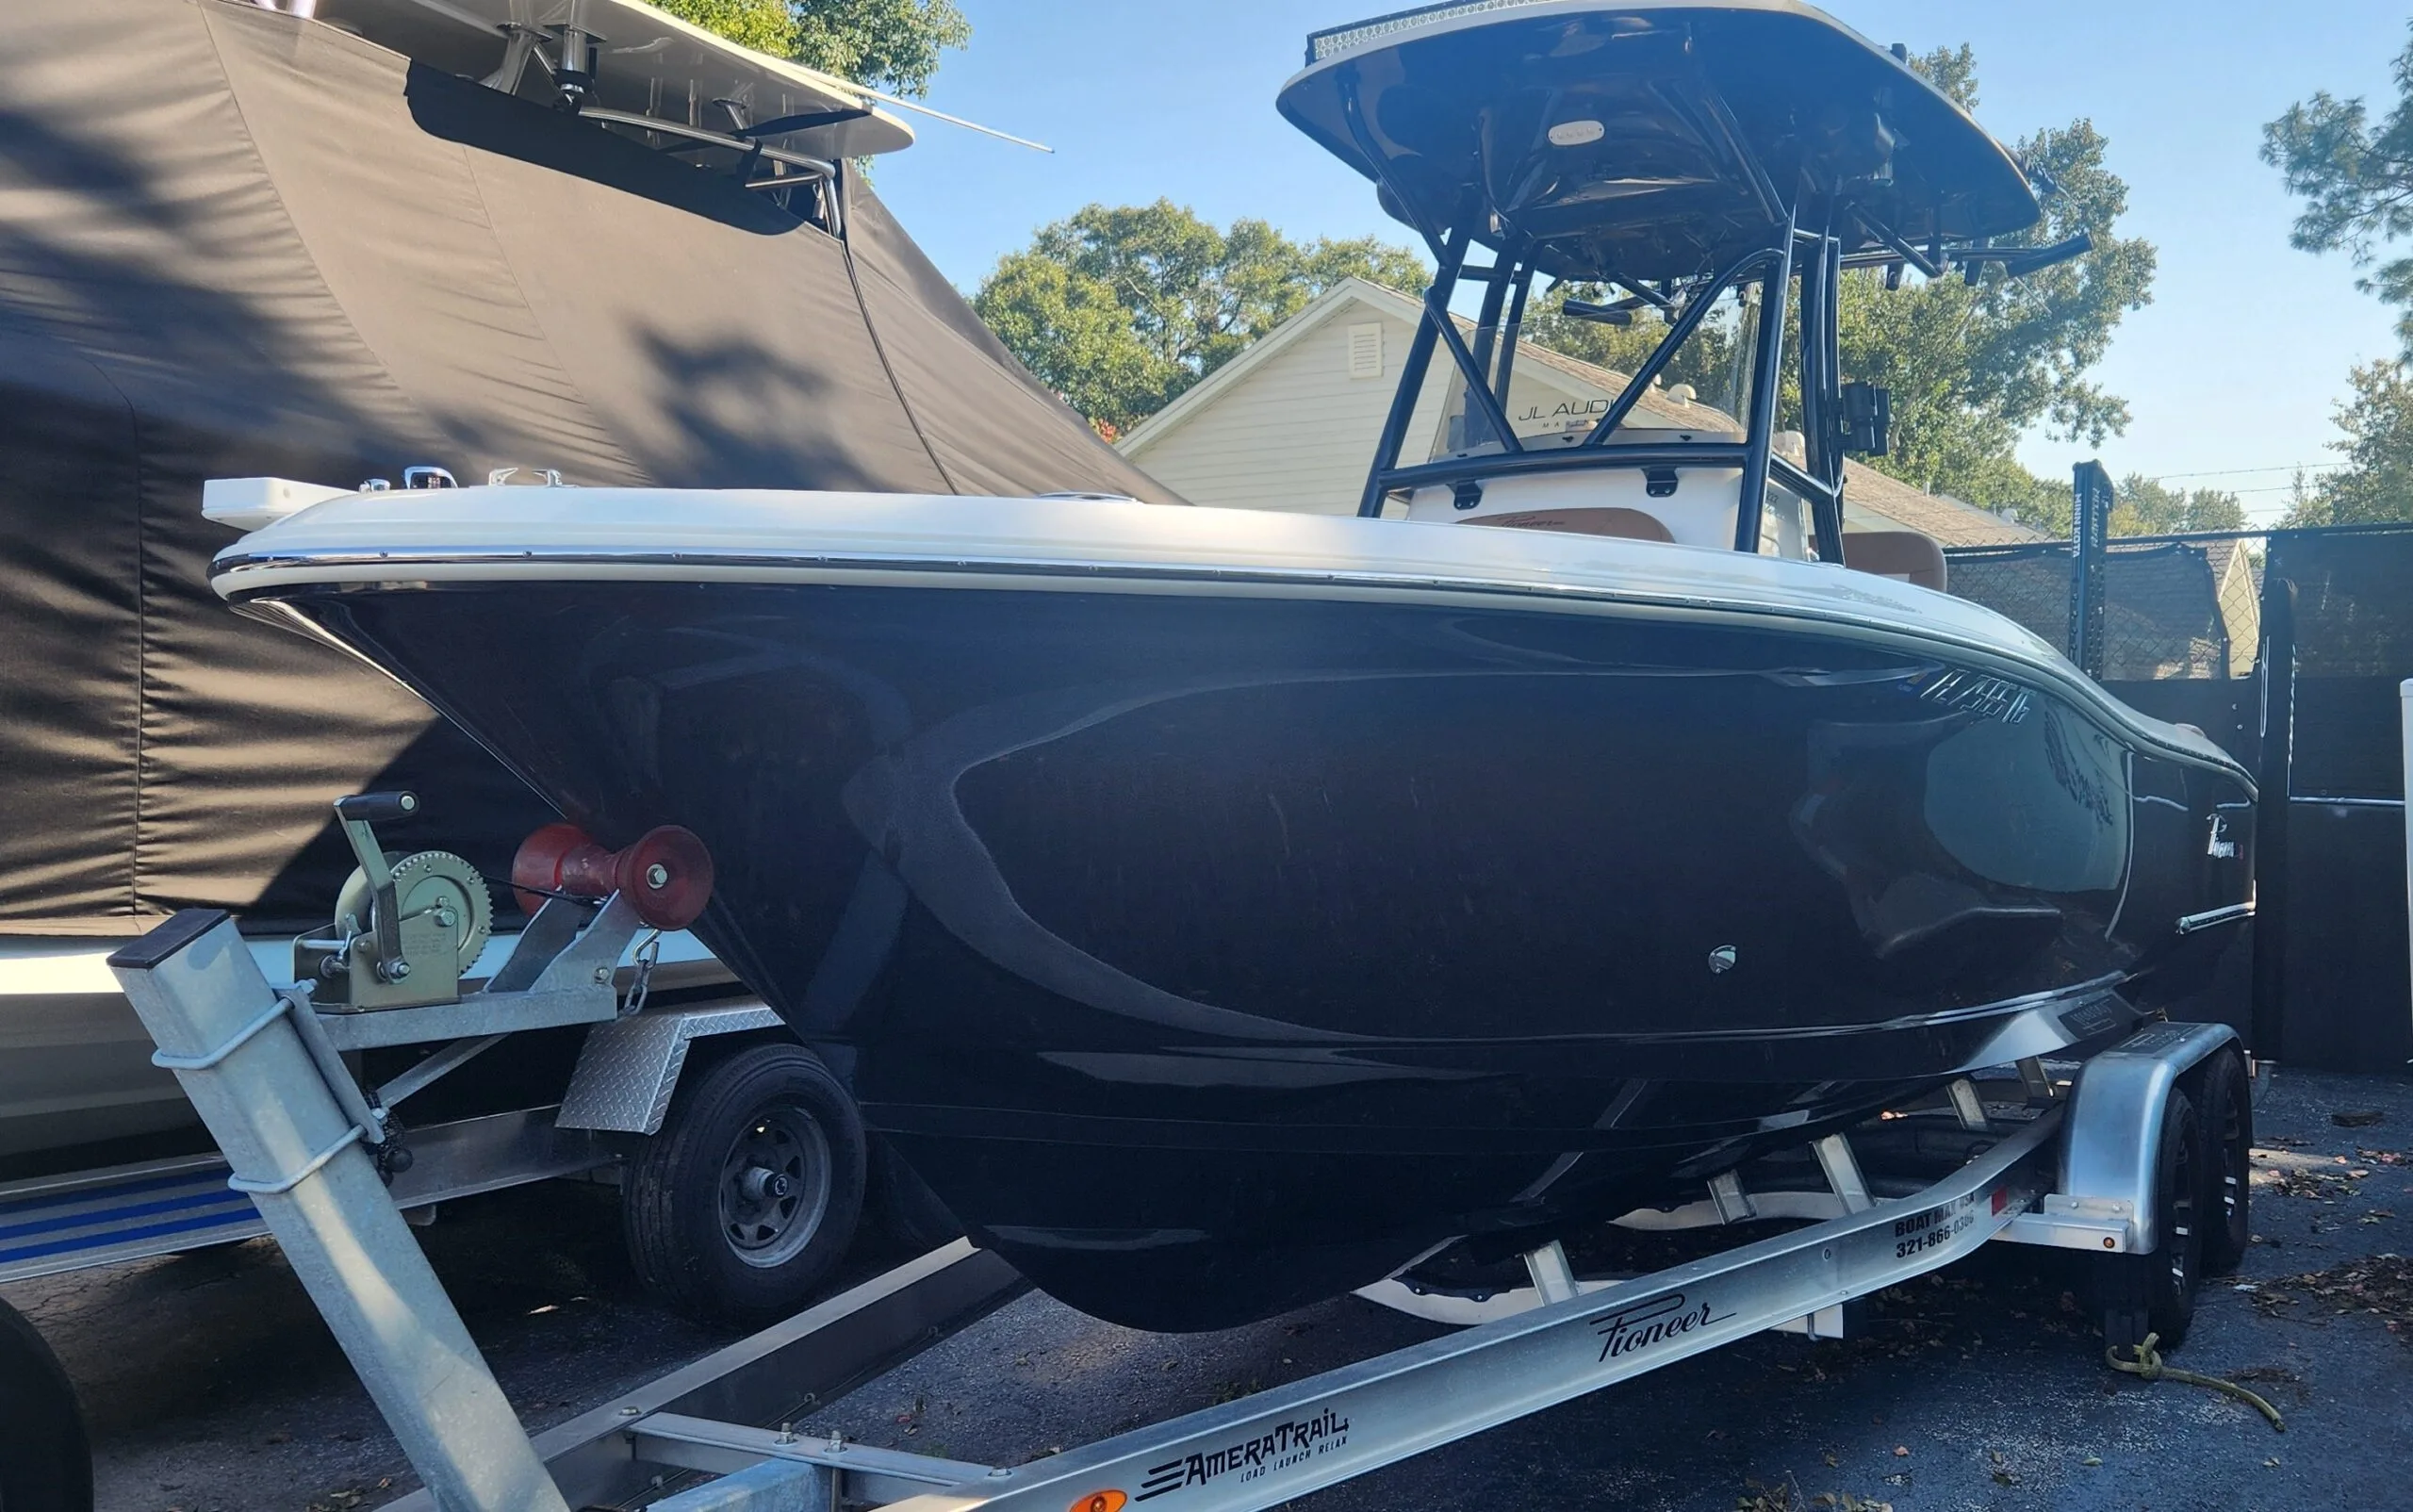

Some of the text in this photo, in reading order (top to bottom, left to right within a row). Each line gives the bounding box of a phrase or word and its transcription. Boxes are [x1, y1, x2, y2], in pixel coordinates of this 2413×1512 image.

[1518, 399, 1615, 421] JL AUDI
[2073, 493, 2082, 558] MINN KOTA
[1895, 1211, 1932, 1237] BOAT
[1589, 1293, 1737, 1362] Pioneer
[1240, 1435, 1348, 1484] LOAD LAUNCH RELAX
